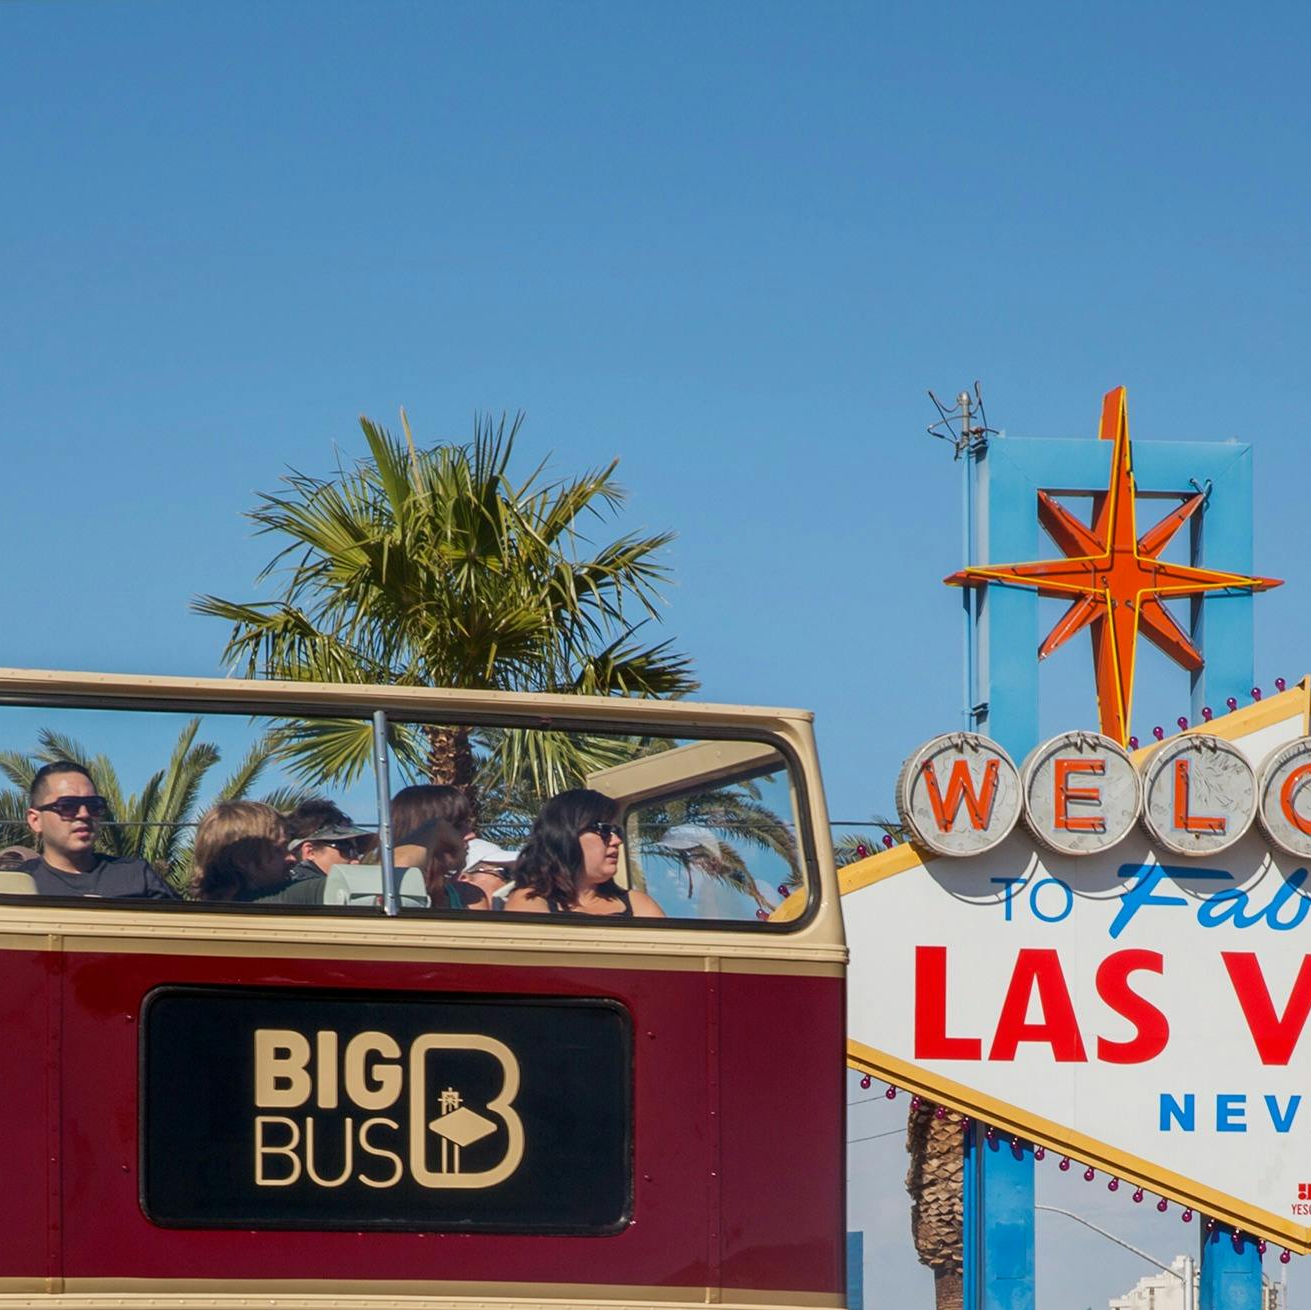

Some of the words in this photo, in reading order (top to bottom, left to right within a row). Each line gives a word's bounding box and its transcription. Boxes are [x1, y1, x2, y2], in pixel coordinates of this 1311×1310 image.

[990, 877, 1074, 923] TO
[913, 946, 1169, 1064] LAS
[254, 1029, 403, 1111] BIG
[254, 1115, 404, 1189] BUS
